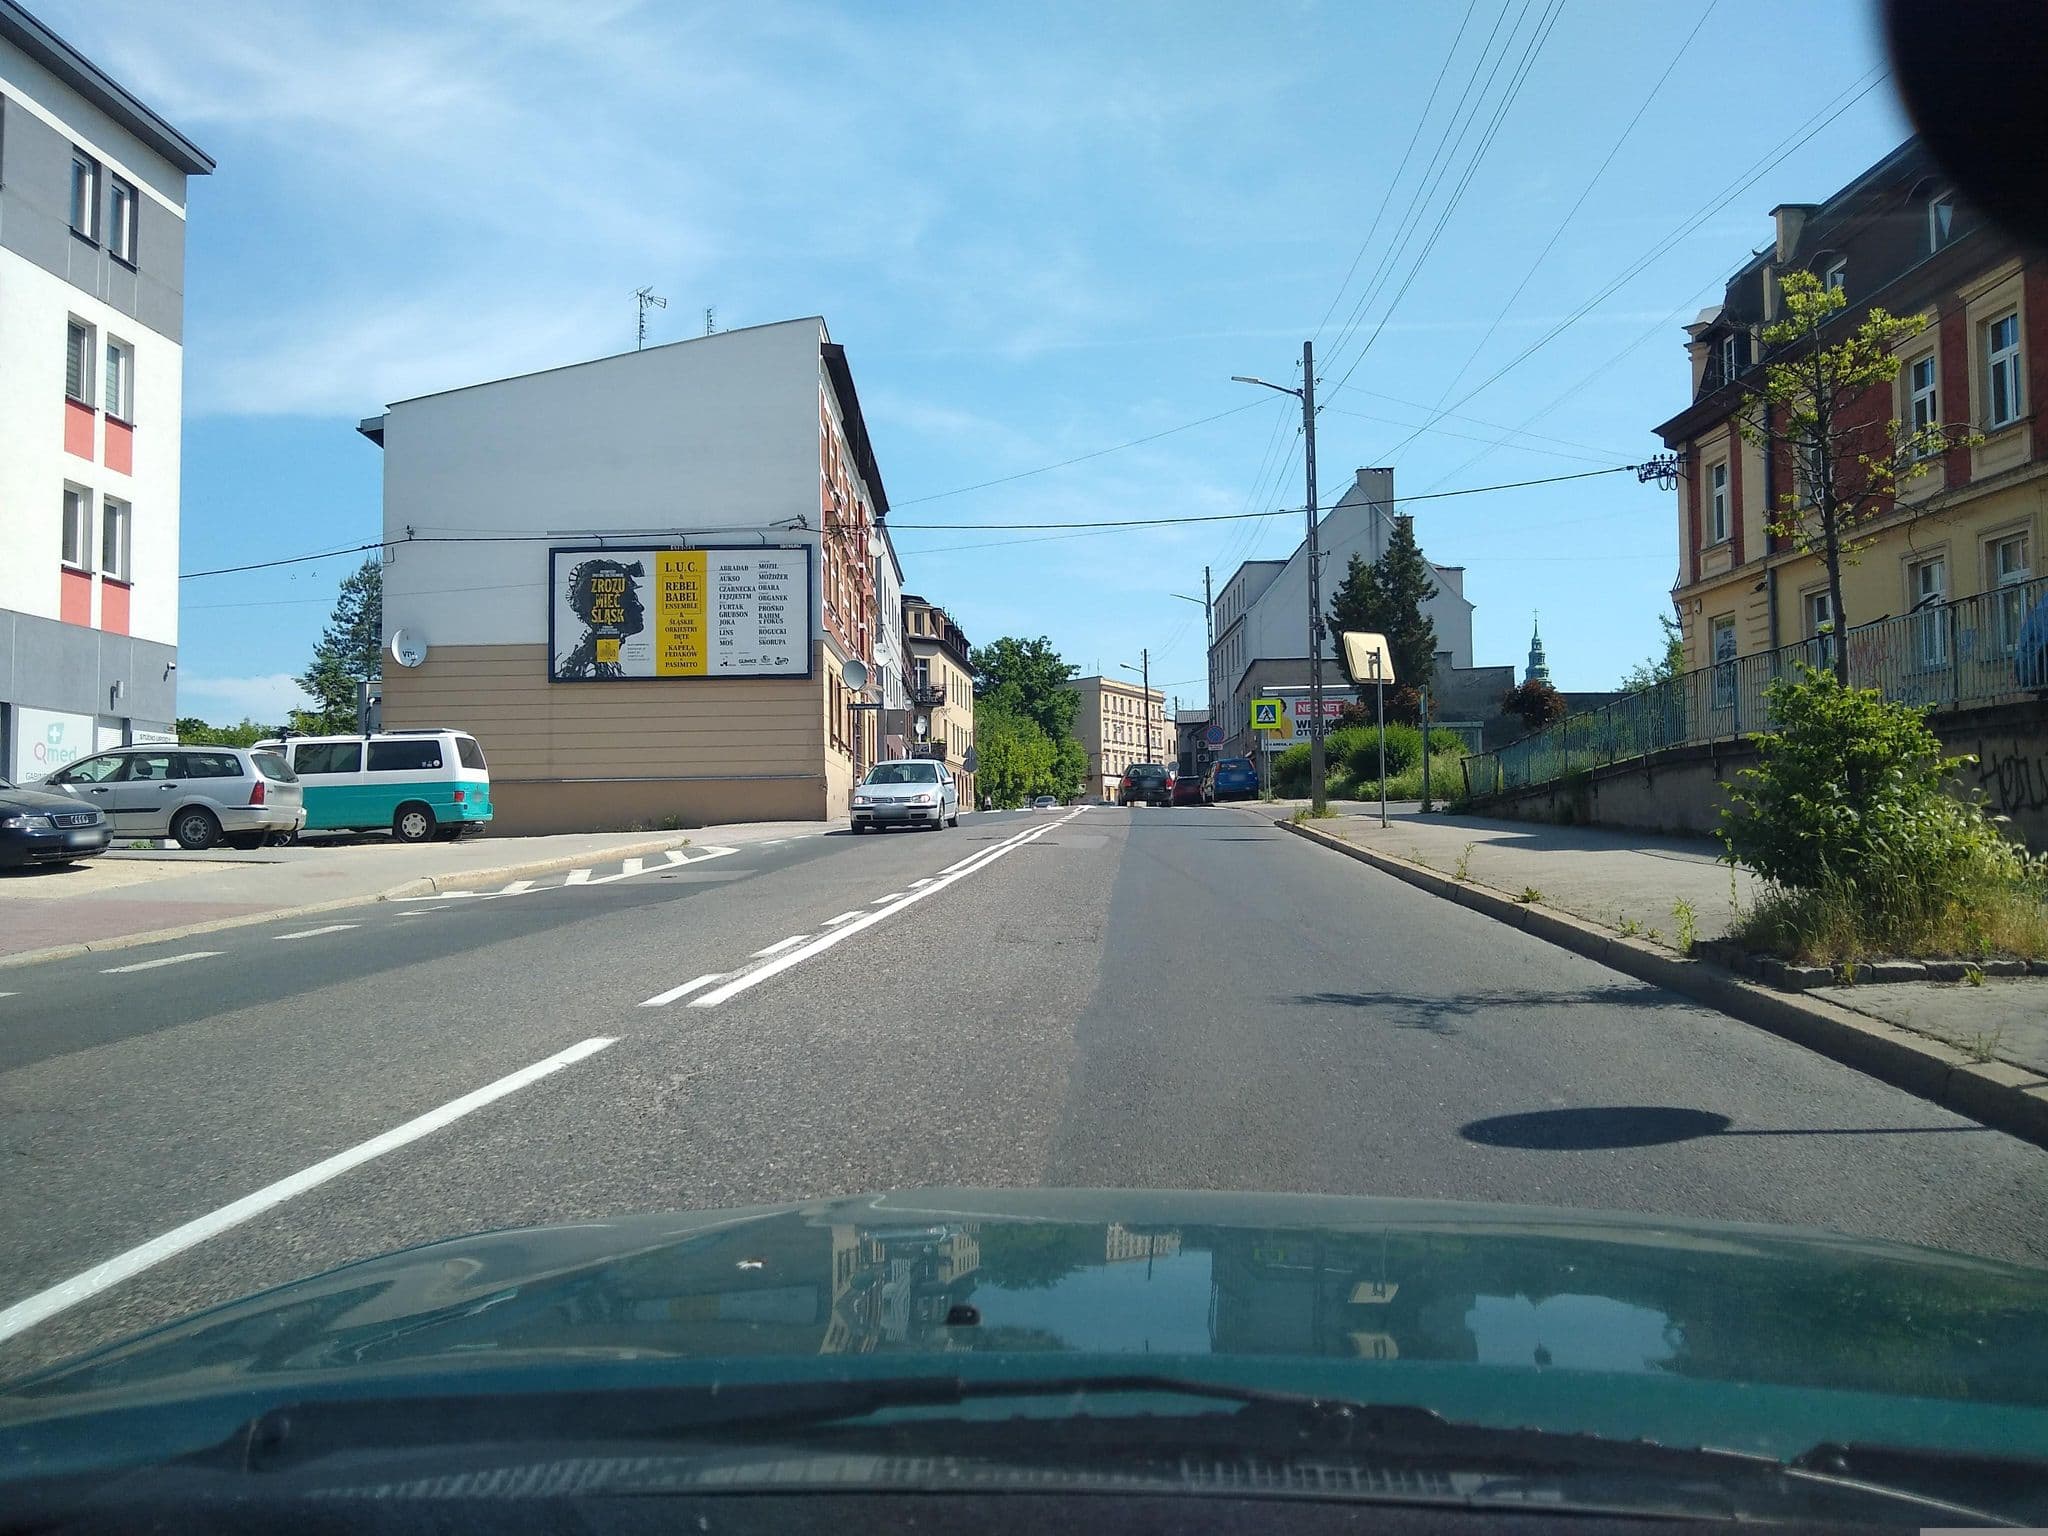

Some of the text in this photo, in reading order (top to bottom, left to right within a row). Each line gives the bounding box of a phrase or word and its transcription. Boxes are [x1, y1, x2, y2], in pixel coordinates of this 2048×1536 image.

[591, 578, 626, 594] ZROZU
[665, 581, 698, 591] REBEL
[665, 592, 698, 602] BABEL
[1298, 703, 1340, 713] NENET
